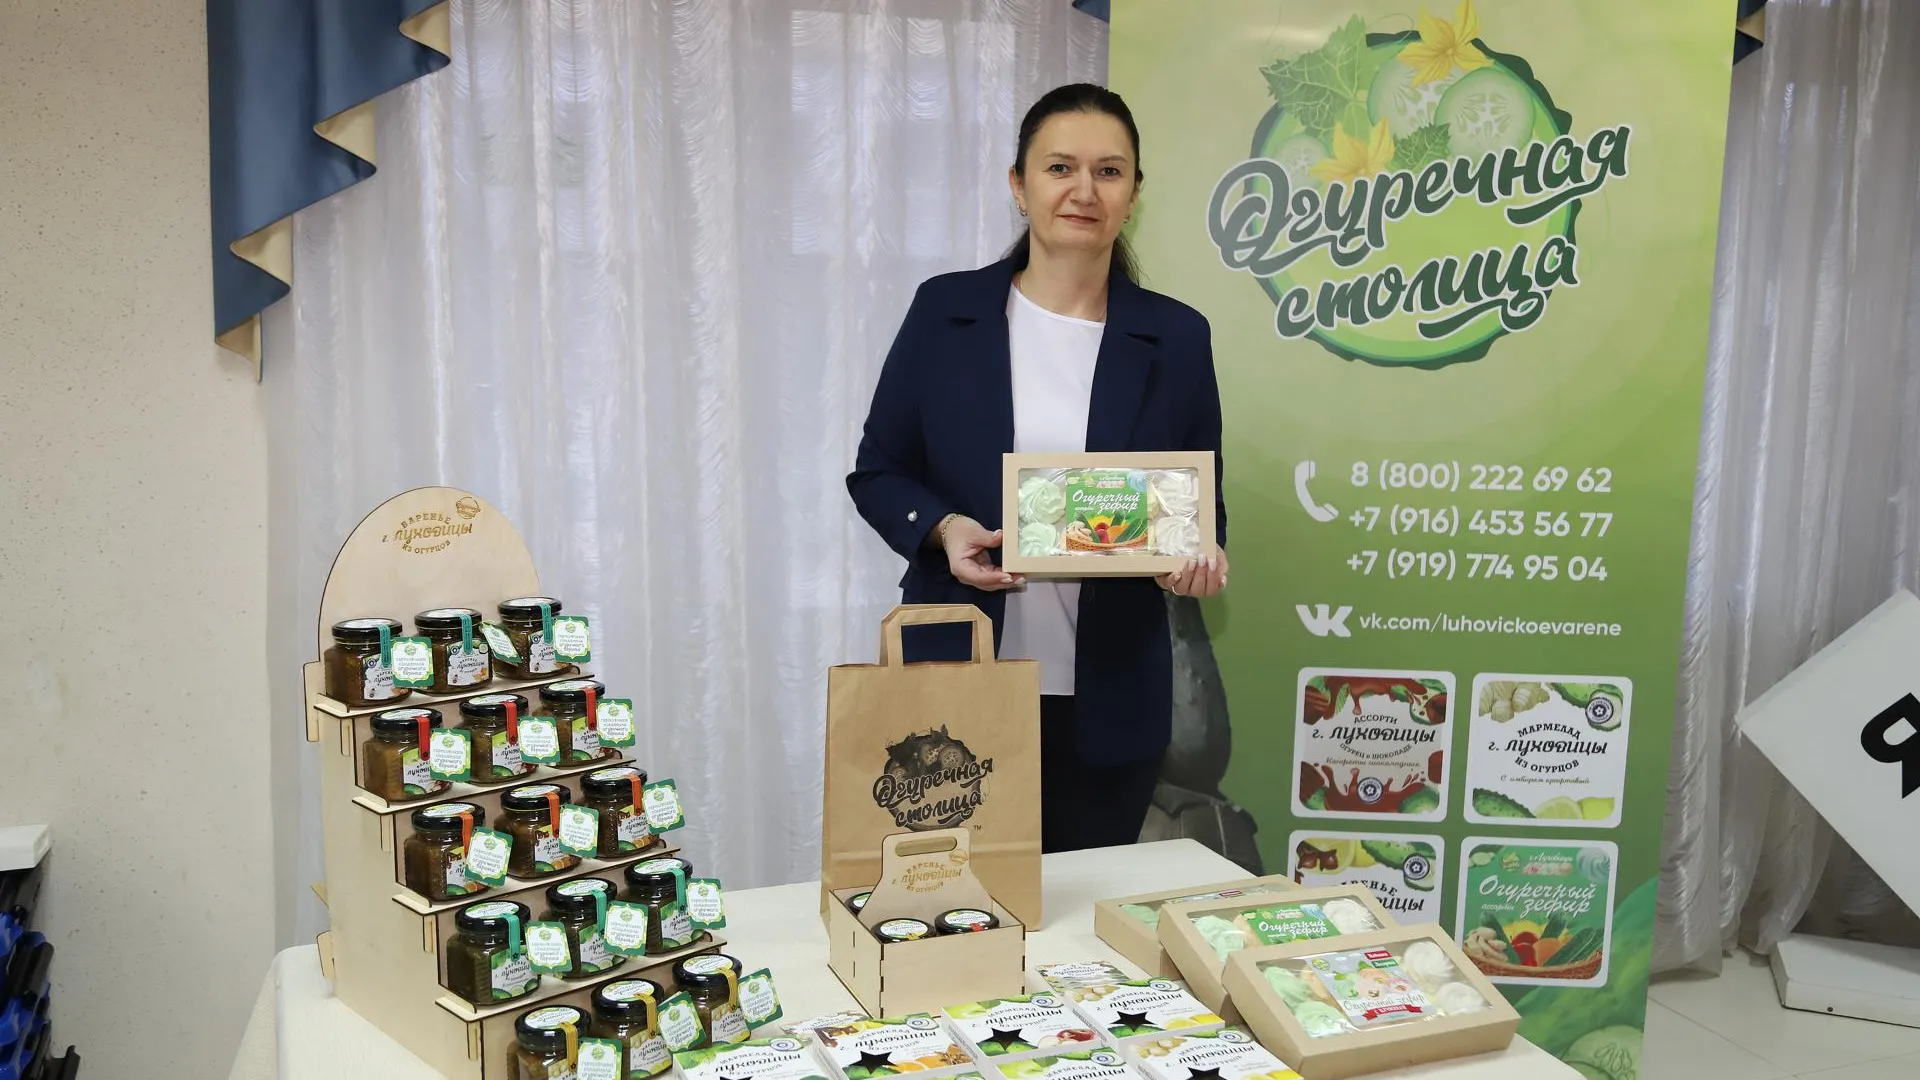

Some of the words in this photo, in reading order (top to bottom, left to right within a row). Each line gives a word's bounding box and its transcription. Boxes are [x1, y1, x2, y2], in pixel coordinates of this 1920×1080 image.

[1207, 122, 1633, 277] Огуречная
[1275, 236, 1580, 341] столица
[1350, 461, 1369, 487] 8
[1379, 460, 1460, 492] (800)
[1469, 465, 1523, 491] 222
[1532, 467, 1568, 492] 69
[1576, 467, 1613, 493] 62
[1072, 488, 1140, 506] Огуречный
[1097, 500, 1138, 515] зефир
[1349, 507, 1381, 532] +7
[1390, 505, 1460, 537] (916)
[1469, 510, 1524, 535] 453
[1534, 511, 1570, 537] 56
[1579, 512, 1613, 537] 77
[1347, 551, 1378, 576] +7
[1387, 548, 1456, 581] (919)
[1466, 553, 1514, 579] 774
[1524, 555, 1559, 581] 95
[1567, 556, 1608, 581] 04
[1359, 611, 1622, 637] vk.com/luhovickoevarene
[1353, 714, 1398, 725] АССОРТИ
[1312, 729, 1324, 739] г.
[1517, 723, 1582, 740] МАРМЕЛАД
[1339, 743, 1366, 759] ОГУРЕЦ
[1371, 744, 1414, 760] ШОКОЛАДЕ
[1488, 741, 1499, 751] г.
[1514, 756, 1528, 769] ИЗ
[1531, 759, 1580, 774] ОГУРЦОВ
[872, 757, 994, 809] Огуречная
[895, 791, 984, 828] столица
[1479, 875, 1598, 902] Огуречный
[1519, 898, 1591, 918] зефир
